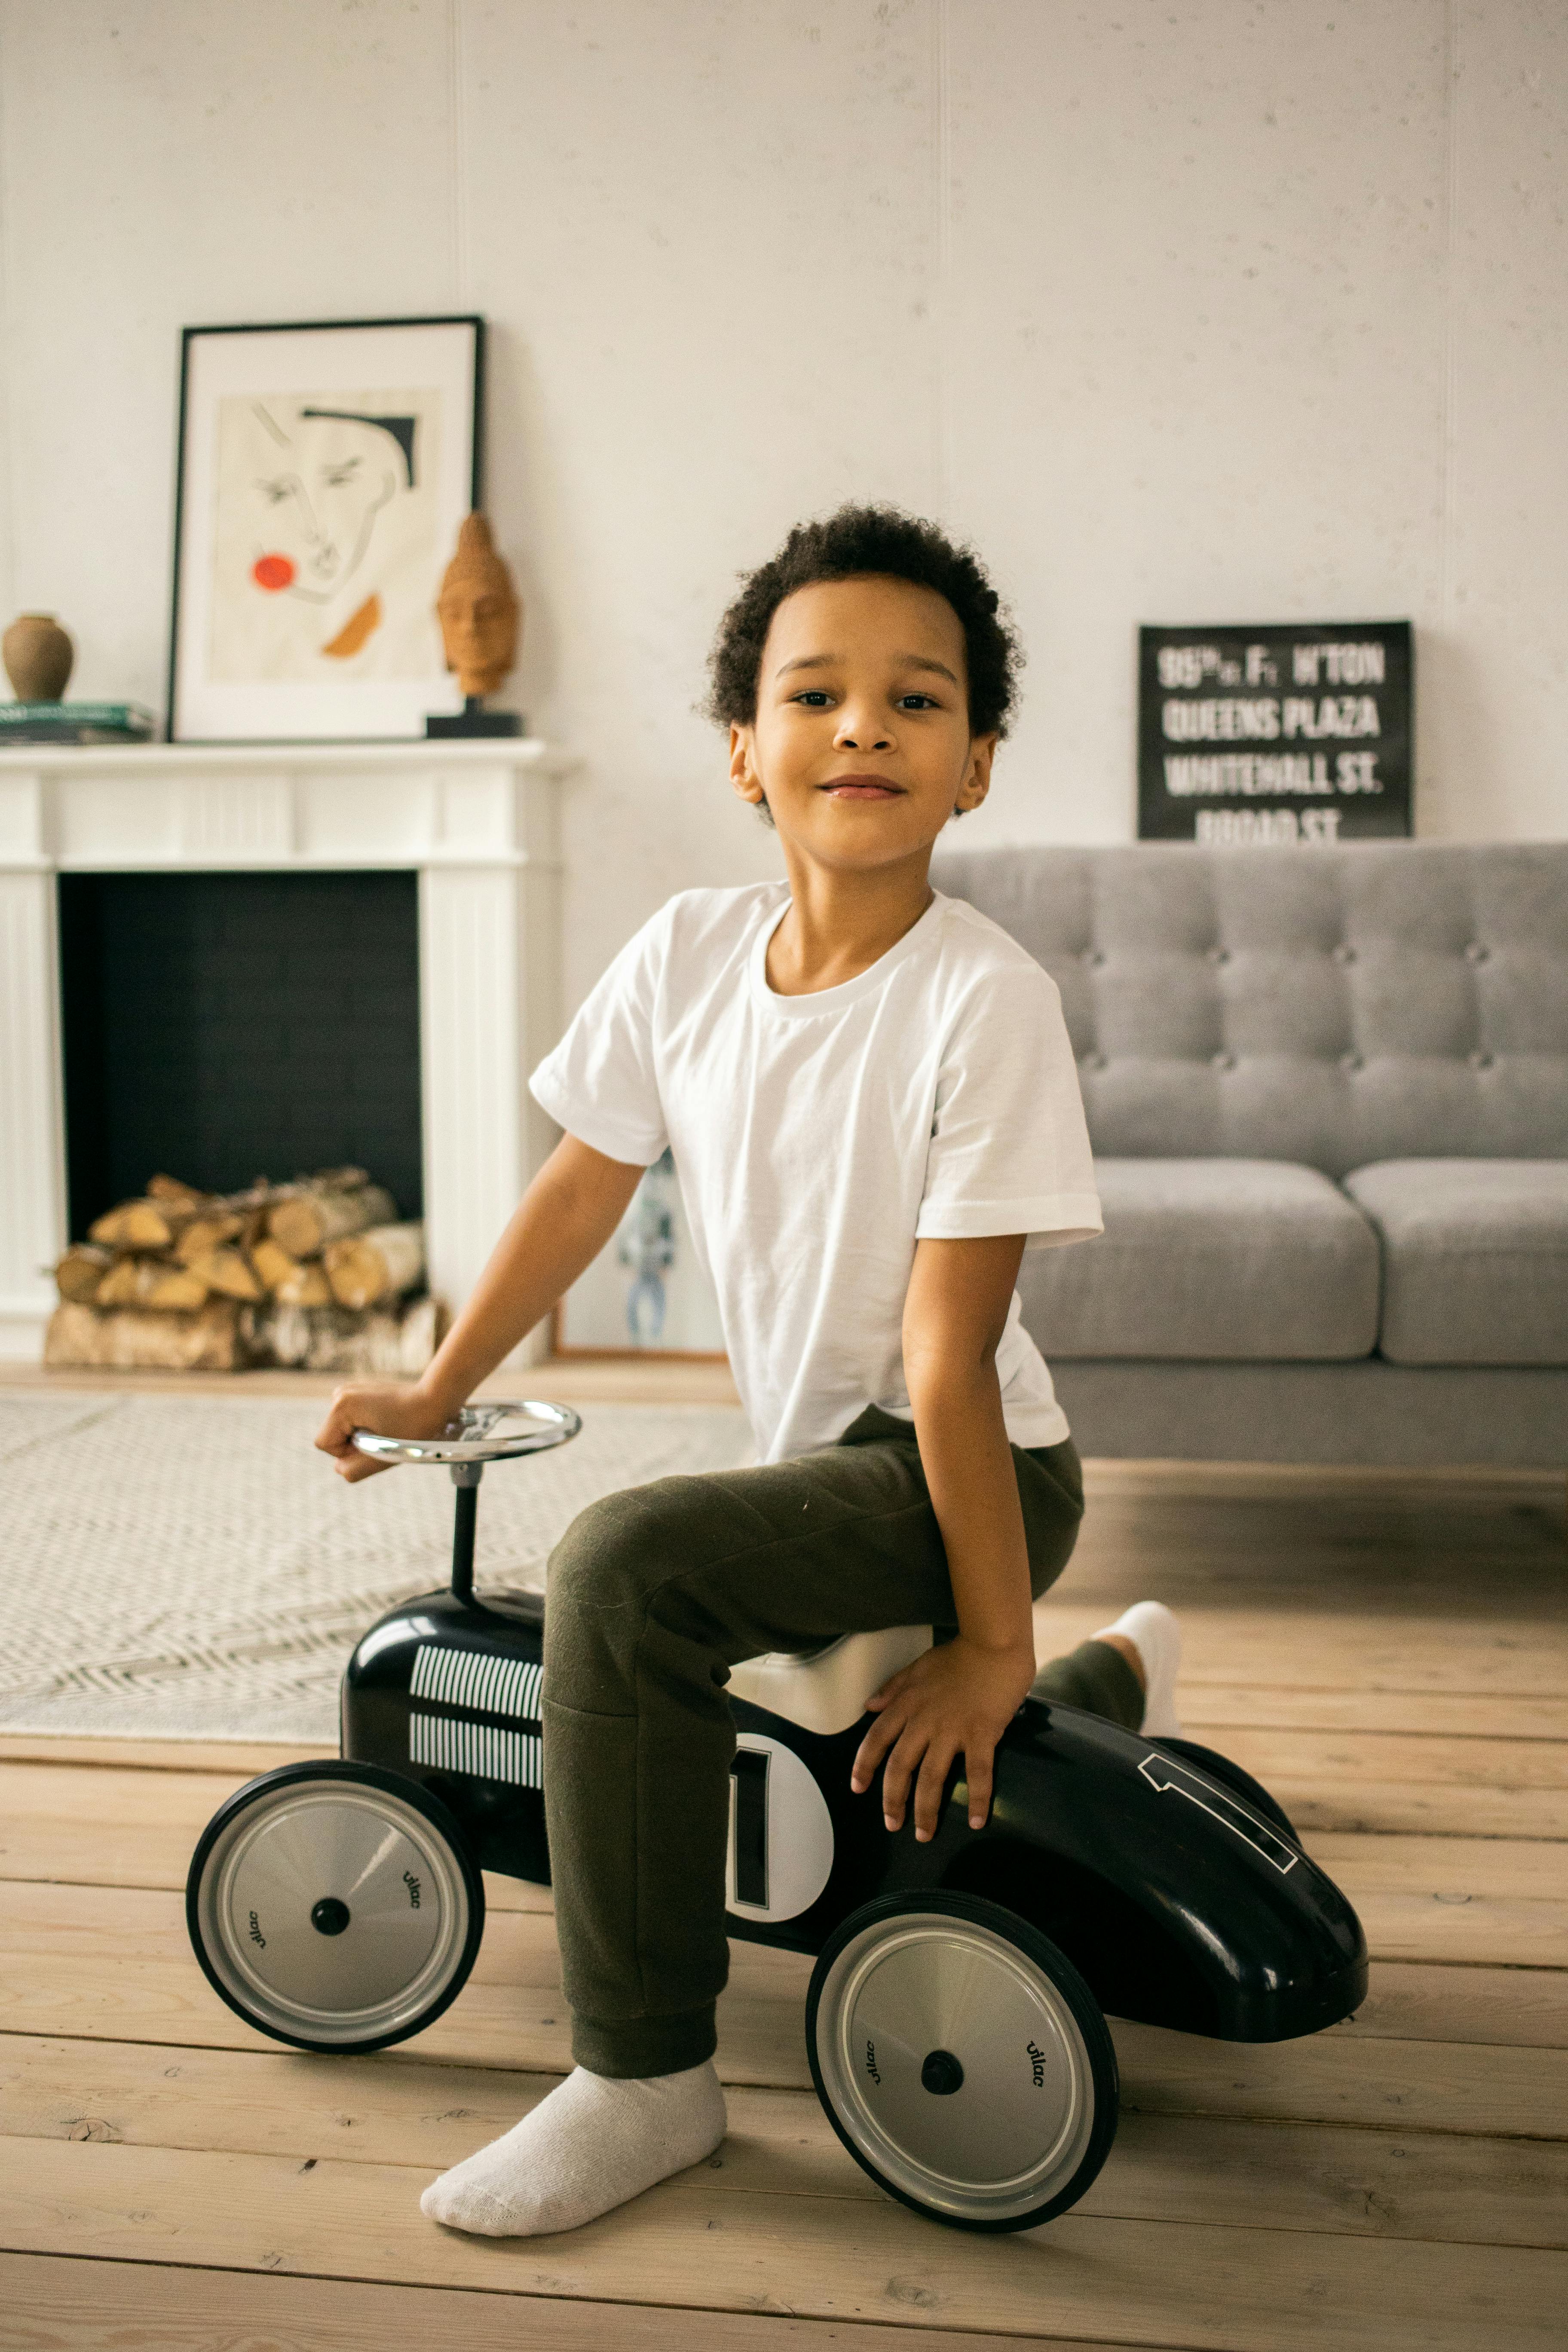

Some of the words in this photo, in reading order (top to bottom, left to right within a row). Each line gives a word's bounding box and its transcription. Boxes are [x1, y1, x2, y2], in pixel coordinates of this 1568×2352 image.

[1164, 698, 1278, 740] QUEENS
[1284, 696, 1379, 738] PLAZA
[1165, 754, 1333, 795] WHITEHALL
[1337, 752, 1382, 794] ST.
[403, 1871, 420, 1909] vilac
[249, 1911, 265, 1949] vilac
[867, 2040, 880, 2086] vilac
[1026, 2040, 1046, 2088] vilac
